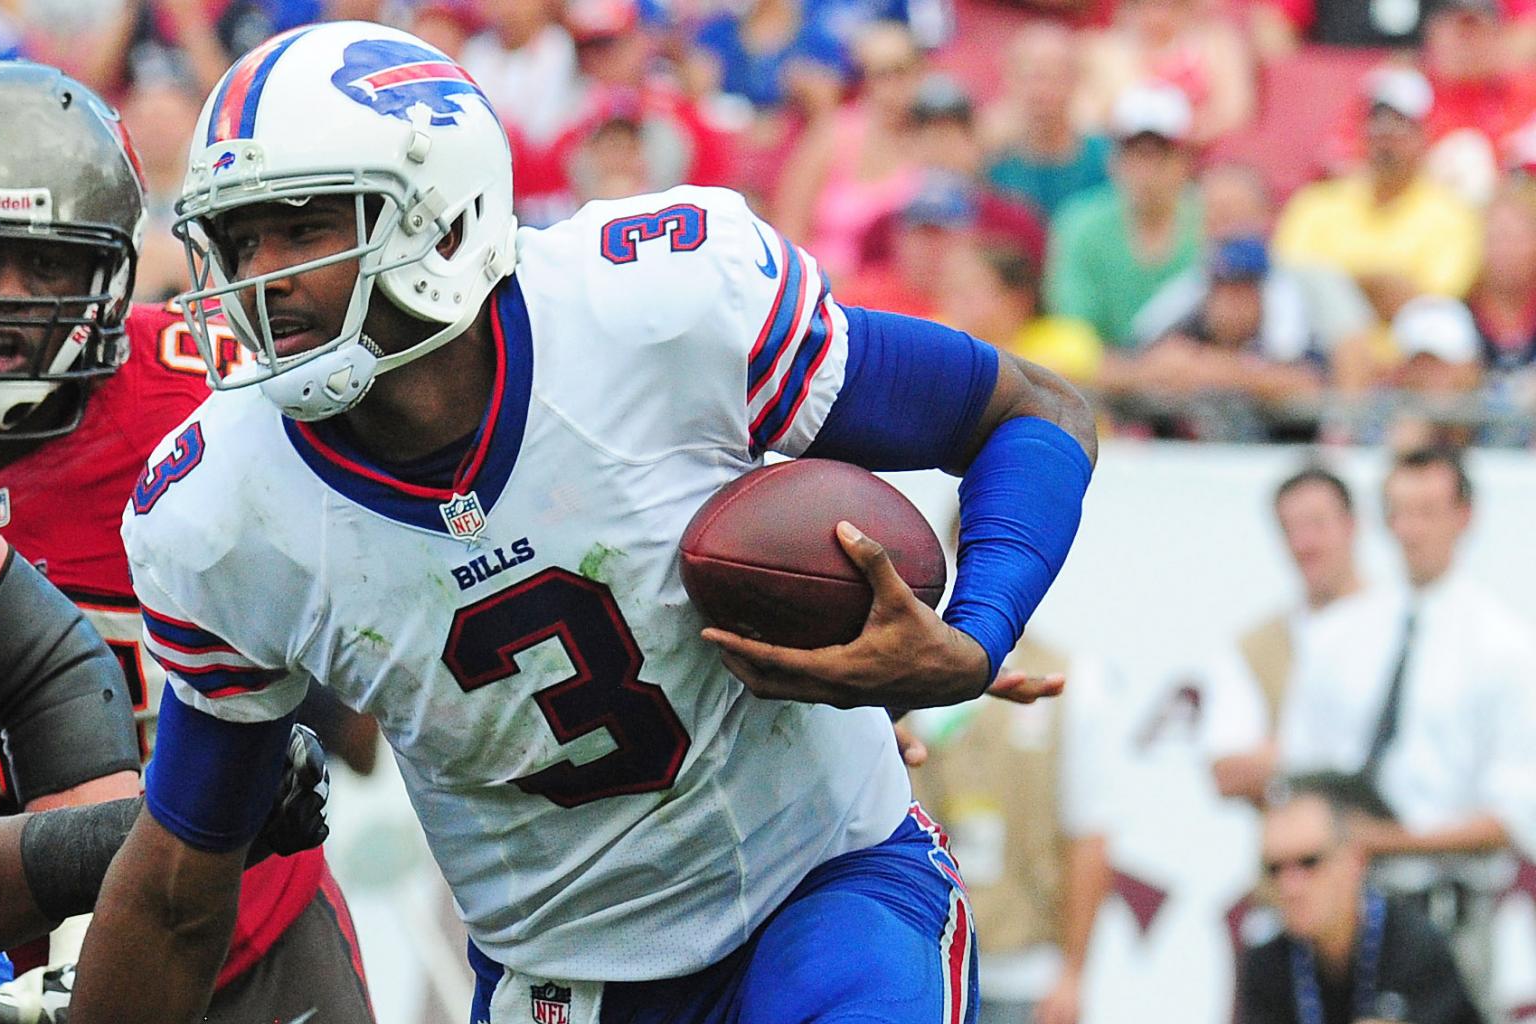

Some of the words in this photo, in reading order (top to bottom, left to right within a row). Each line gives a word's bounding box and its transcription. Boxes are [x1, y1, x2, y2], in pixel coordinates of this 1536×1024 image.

[601, 203, 708, 265] 3
[132, 421, 206, 516] 3
[452, 509, 481, 535] NFL
[451, 537, 536, 591] BILLS
[441, 566, 693, 809] 3
